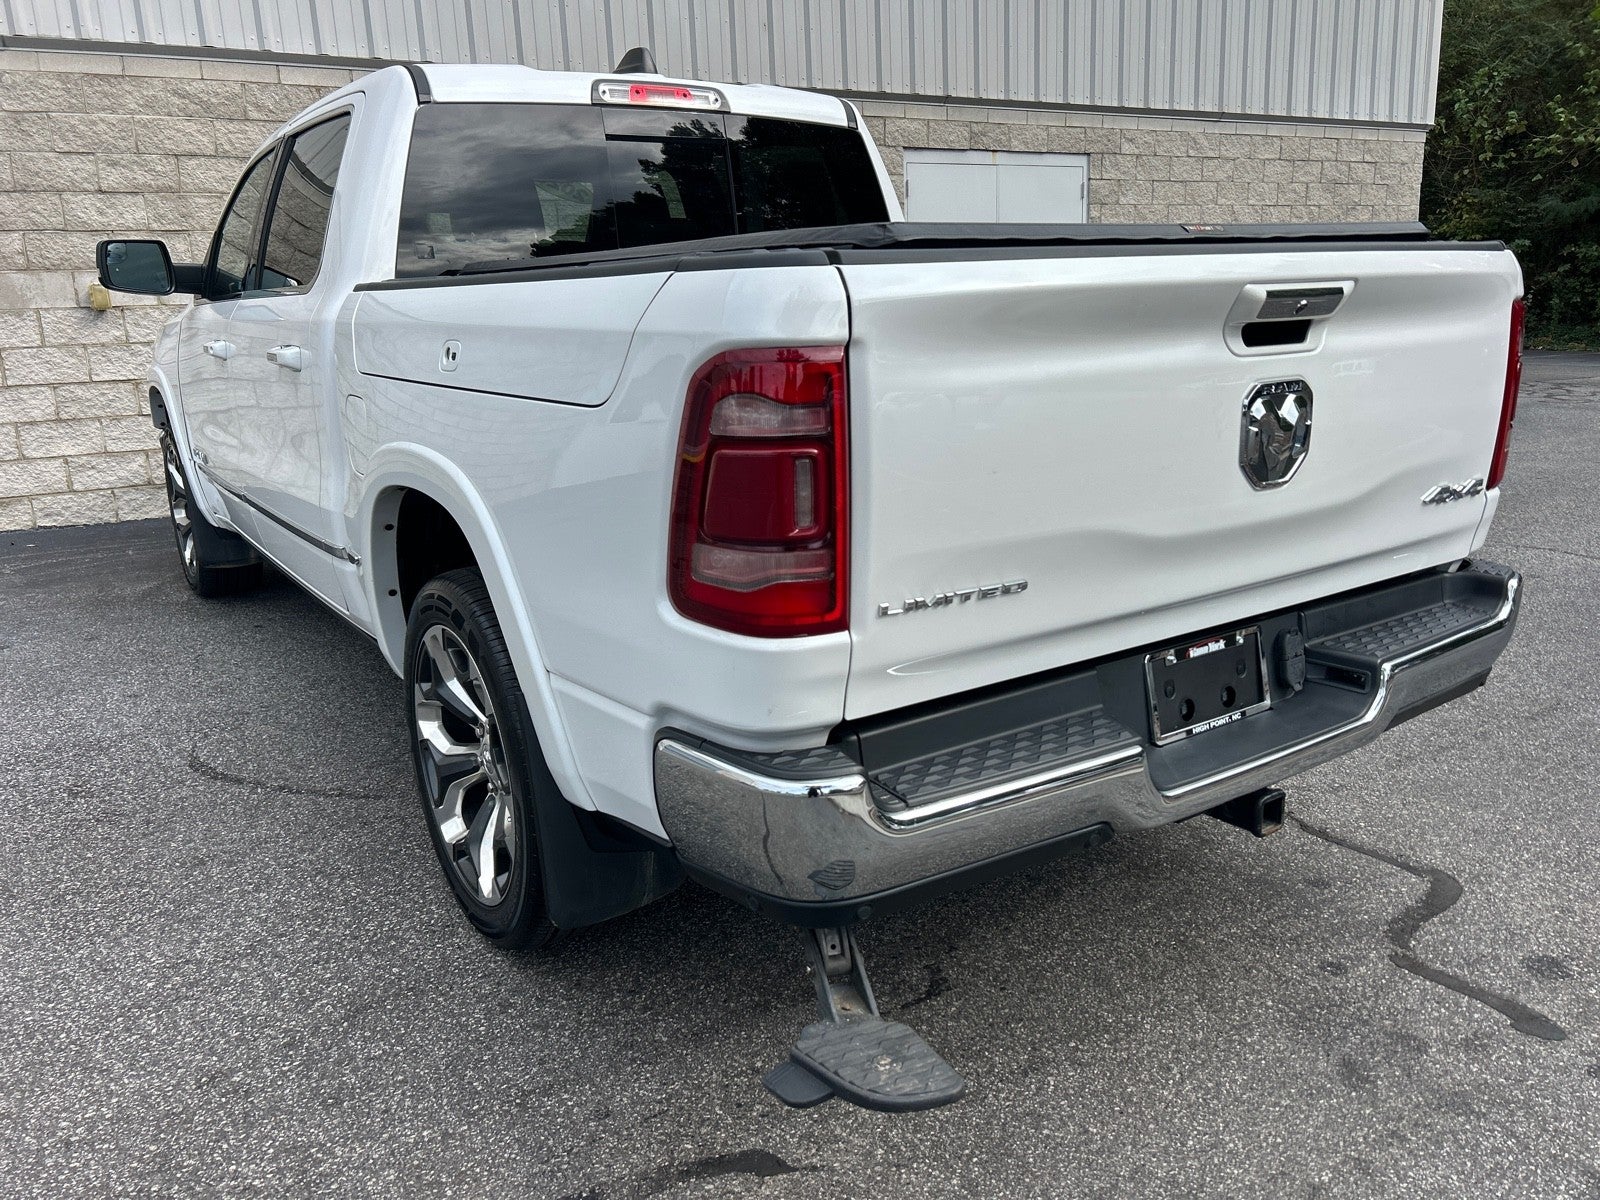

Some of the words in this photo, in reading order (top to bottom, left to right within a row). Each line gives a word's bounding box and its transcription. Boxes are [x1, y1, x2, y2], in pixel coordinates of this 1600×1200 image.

[1262, 381, 1302, 395] RAM
[878, 579, 1028, 616] LIMITED
[1192, 723, 1209, 734] HIGH
[1231, 712, 1242, 721] NC
